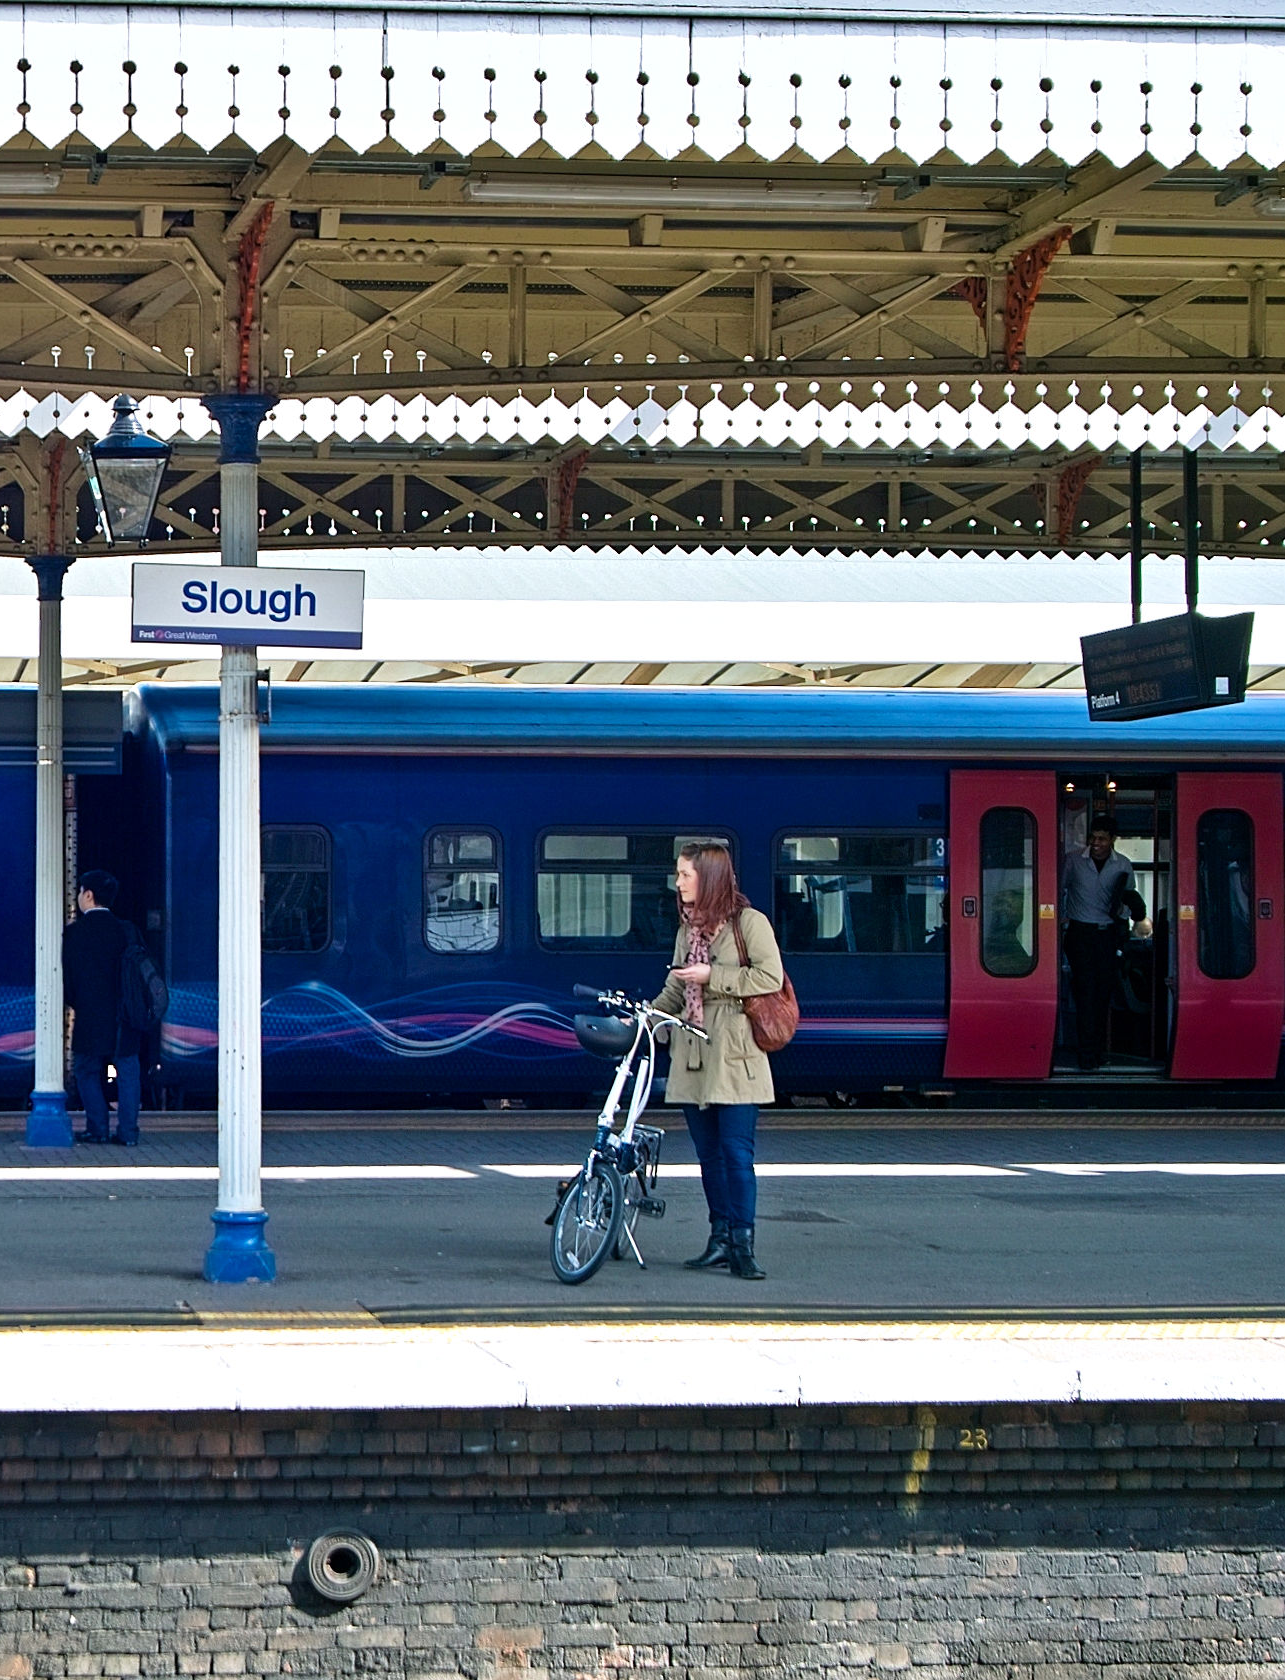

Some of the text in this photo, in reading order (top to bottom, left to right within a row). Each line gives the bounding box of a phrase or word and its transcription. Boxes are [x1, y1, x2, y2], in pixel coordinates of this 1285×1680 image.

[181, 580, 316, 622] Slough
[139, 630, 218, 640] First Great Western
[1091, 690, 1121, 710] Platform 4
[936, 838, 945, 857] 3
[959, 1428, 988, 1450] 23
